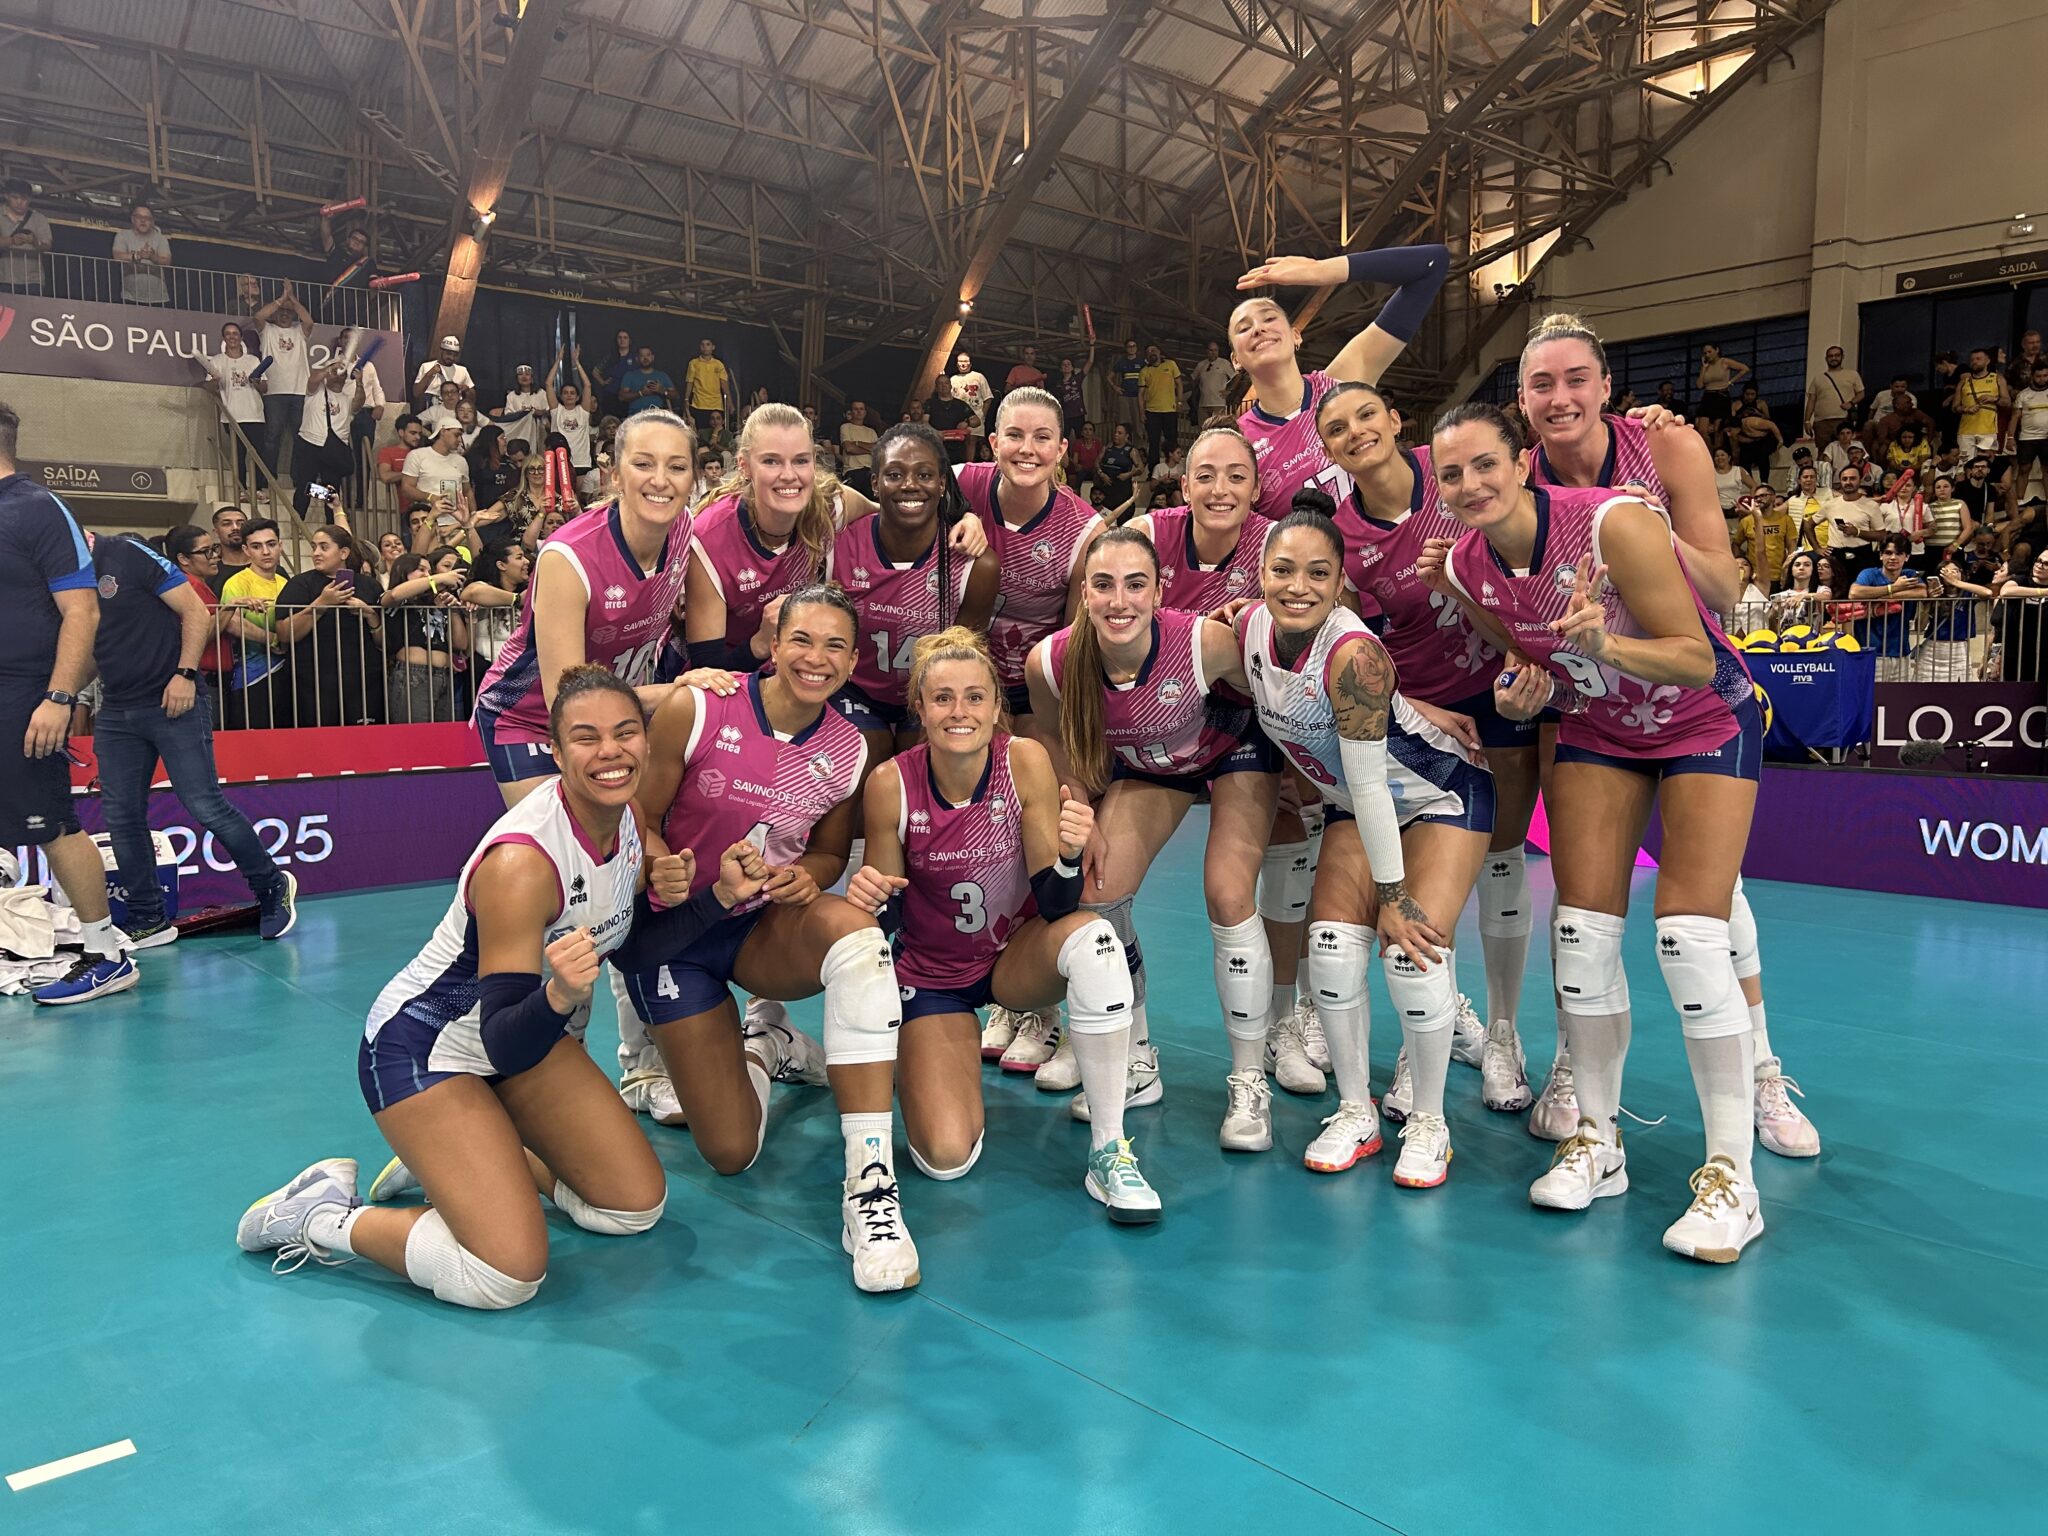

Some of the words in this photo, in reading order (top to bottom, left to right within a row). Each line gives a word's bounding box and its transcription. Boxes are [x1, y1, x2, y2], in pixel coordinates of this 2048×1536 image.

[1948, 272, 1964, 280] EXIT
[30, 314, 114, 352] SÃO
[1282, 448, 1312, 471] SAVINO
[1313, 438, 1325, 450] DE
[43, 465, 100, 481] SAÍDA
[1362, 551, 1385, 568] errea
[1395, 563, 1418, 581] SAVI
[739, 581, 761, 592] errea
[604, 600, 627, 609] errea
[1481, 597, 1500, 606] errea
[869, 602, 904, 615] SAVINO
[906, 610, 924, 620] DEL
[622, 615, 652, 633] SAVINO
[1514, 622, 1550, 632] SAVINO
[1549, 651, 1609, 698] 9
[1770, 662, 1836, 673] VOLLEYBALL
[1792, 674, 1813, 682] FIVB
[1260, 705, 1290, 725] SAVINO
[1291, 718, 1308, 731] DEL
[1104, 728, 1139, 736] AVINO
[1141, 725, 1162, 735] DEL
[715, 740, 741, 754] errea
[1113, 742, 1174, 770] 11
[1230, 752, 1257, 761] errea
[732, 779, 776, 799] SAVINO
[777, 791, 798, 805] DEL
[928, 849, 969, 862] SAVINO
[971, 846, 991, 858] DEL
[950, 880, 988, 935] 3
[589, 914, 620, 938] SAVINO
[1096, 945, 1116, 956] errea
[1317, 942, 1338, 950] errea
[1229, 967, 1248, 975] errea
[1394, 963, 1415, 972] errea
[657, 964, 680, 1000] 4
